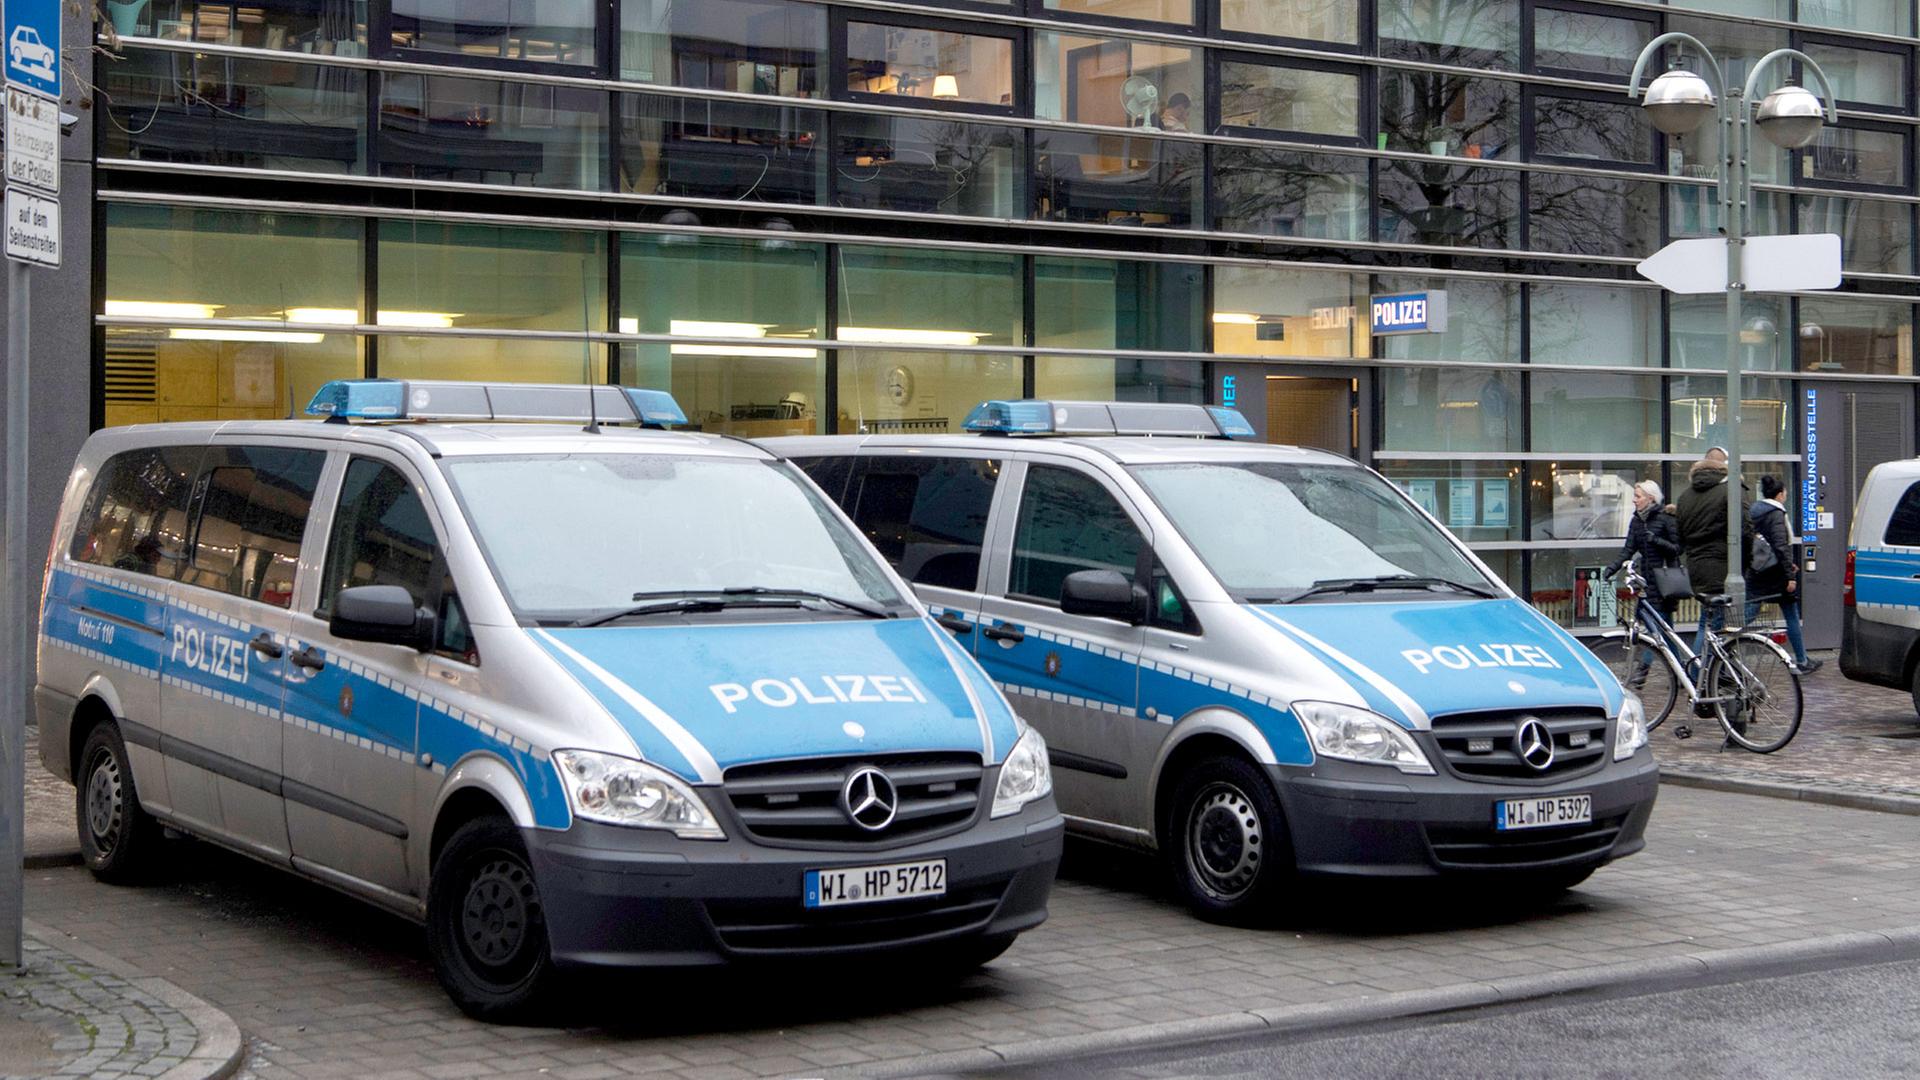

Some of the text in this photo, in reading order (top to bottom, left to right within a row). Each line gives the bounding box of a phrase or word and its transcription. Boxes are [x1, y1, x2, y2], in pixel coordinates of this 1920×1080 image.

[12, 157, 55, 185] der Polizei
[19, 207, 48, 228] auf dem
[9, 226, 57, 254] Seitenstreifen
[1373, 299, 1427, 327] POLIZEI
[1223, 375, 1236, 407] IER
[1807, 389, 1817, 532] BERATUNGSSTELLE
[78, 616, 115, 645] Notruf 110
[171, 624, 250, 683] POLIZEI
[1400, 644, 1562, 674] POLIZEI
[709, 675, 928, 714] POLIZEI
[1507, 802, 1526, 825] WI
[1536, 800, 1555, 823] HP
[1558, 797, 1590, 820] 5392
[820, 873, 847, 901] WI
[864, 870, 891, 898] HP
[896, 864, 943, 894] 5712
